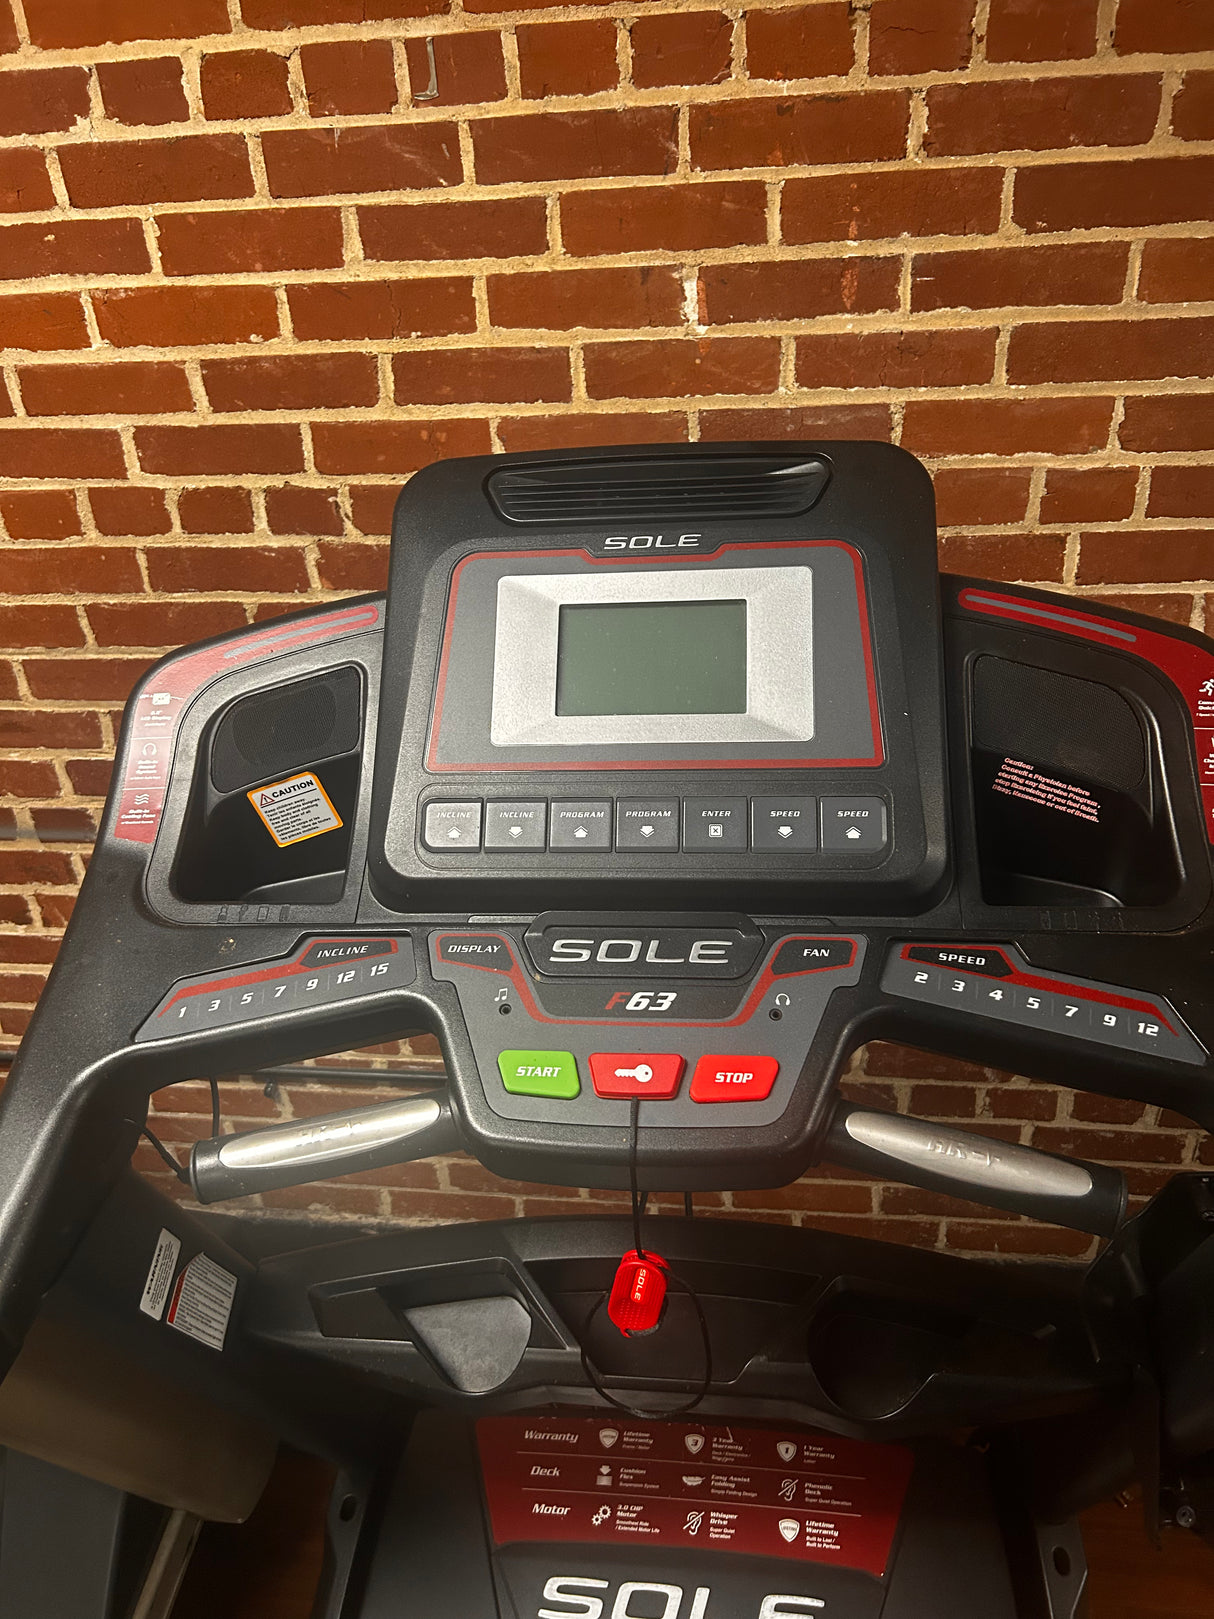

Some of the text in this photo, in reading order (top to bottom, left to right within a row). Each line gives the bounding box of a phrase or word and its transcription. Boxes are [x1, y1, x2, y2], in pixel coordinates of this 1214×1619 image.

[604, 534, 701, 550] SOLE
[272, 780, 313, 798] CAUTION
[317, 945, 369, 958] INCLINE
[448, 945, 500, 953] DISPLAY
[550, 939, 733, 964] SOLE
[803, 948, 830, 957] FAN
[938, 952, 986, 966] SPEED
[178, 962, 390, 1018] 1 3 5 7 9 12 15
[604, 992, 677, 1011] F63
[914, 972, 1160, 1036] 2 3 4 5 7 9 12
[516, 1066, 562, 1078] START
[714, 1072, 754, 1084] STOP
[634, 1268, 646, 1301] SOLE
[524, 1430, 579, 1444] Warranty
[530, 1466, 560, 1476] Deck
[532, 1504, 571, 1515] Motor
[806, 1520, 834, 1528] Lifetime
[806, 1527, 838, 1536] Warranty
